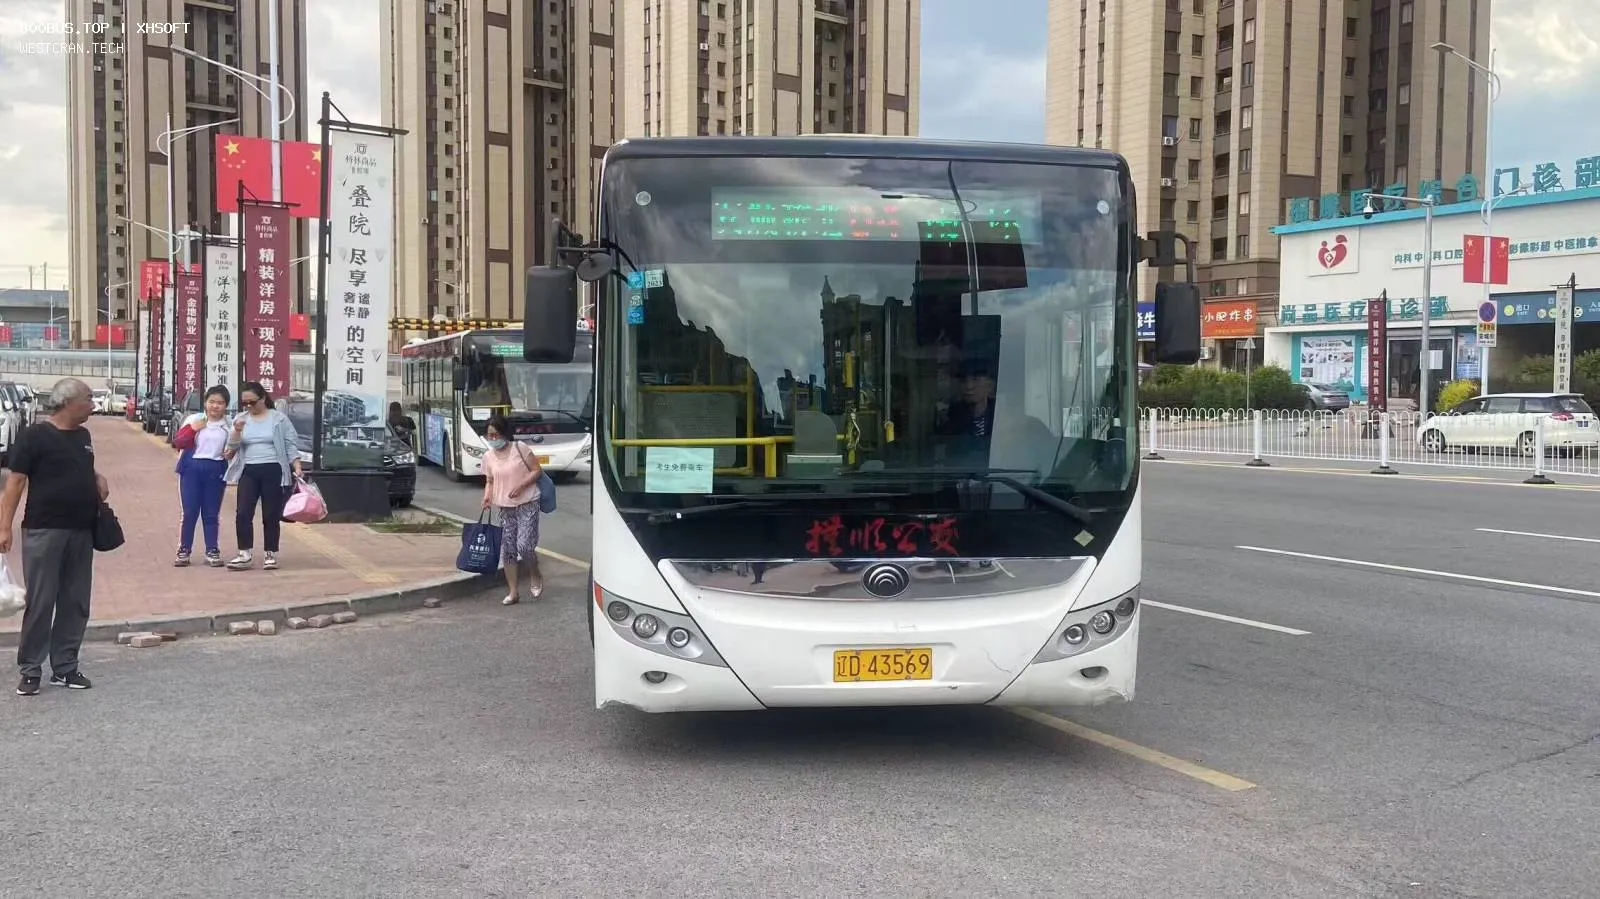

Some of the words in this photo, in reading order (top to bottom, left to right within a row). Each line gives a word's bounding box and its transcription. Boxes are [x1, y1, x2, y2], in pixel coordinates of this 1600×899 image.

[1394, 253, 1412, 264] 内科
[1414, 250, 1442, 262] 中科
[1554, 236, 1598, 251] 中医推拿
[217, 275, 231, 304] 洋房
[258, 247, 275, 315] 精装洋房
[186, 297, 197, 335] 金地物业
[1204, 308, 1253, 323] 小肥炸串
[258, 326, 275, 394] 现房热售
[346, 325, 366, 386] 的空间
[656, 463, 703, 472] 考生免费乘车
